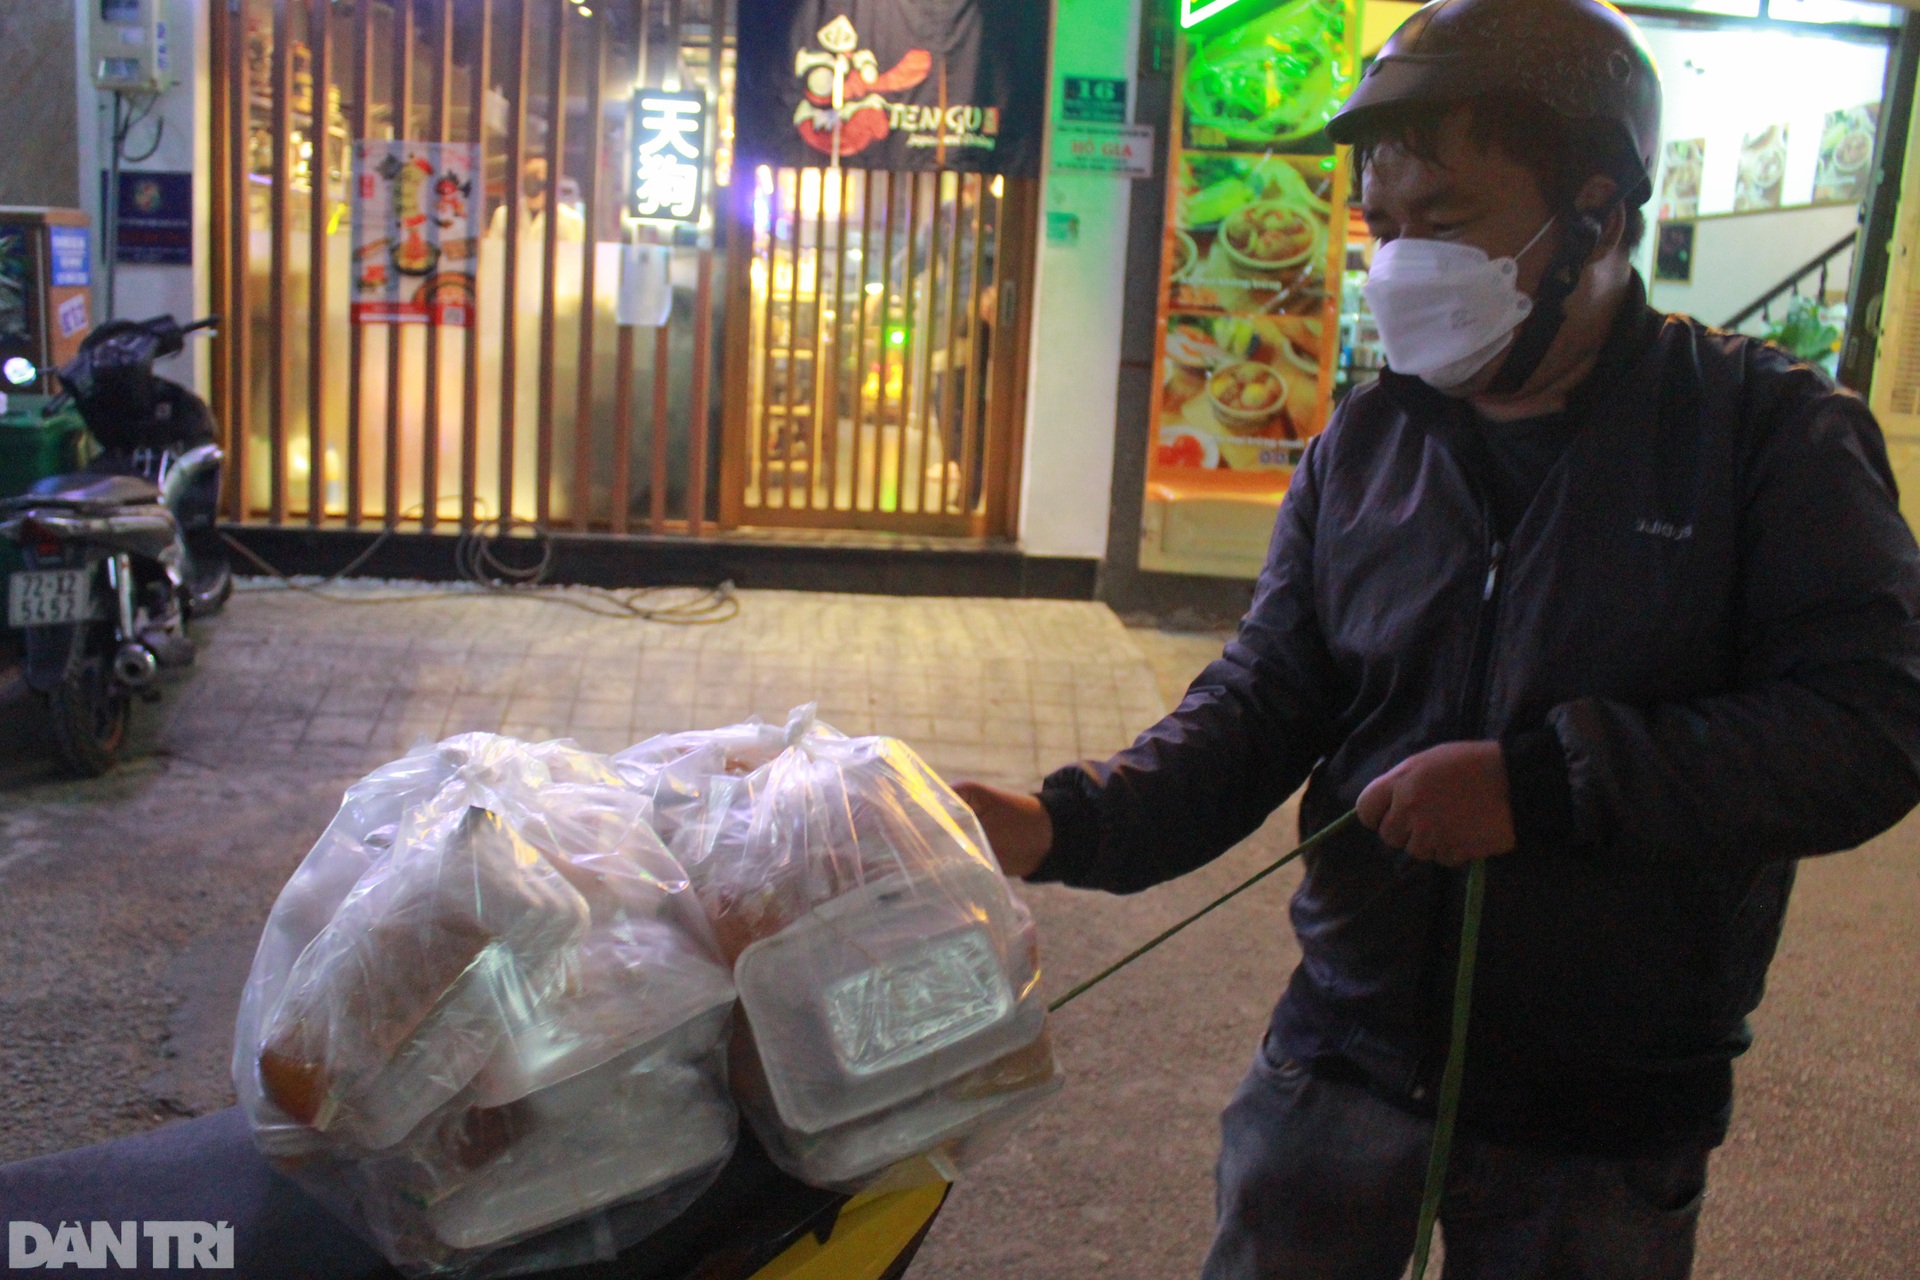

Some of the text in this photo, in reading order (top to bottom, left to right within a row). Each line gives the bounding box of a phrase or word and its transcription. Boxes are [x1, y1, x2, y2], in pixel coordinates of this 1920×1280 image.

[1080, 80, 1116, 100] 16
[889, 103, 982, 134] TENGU
[636, 98, 701, 217] 天狗
